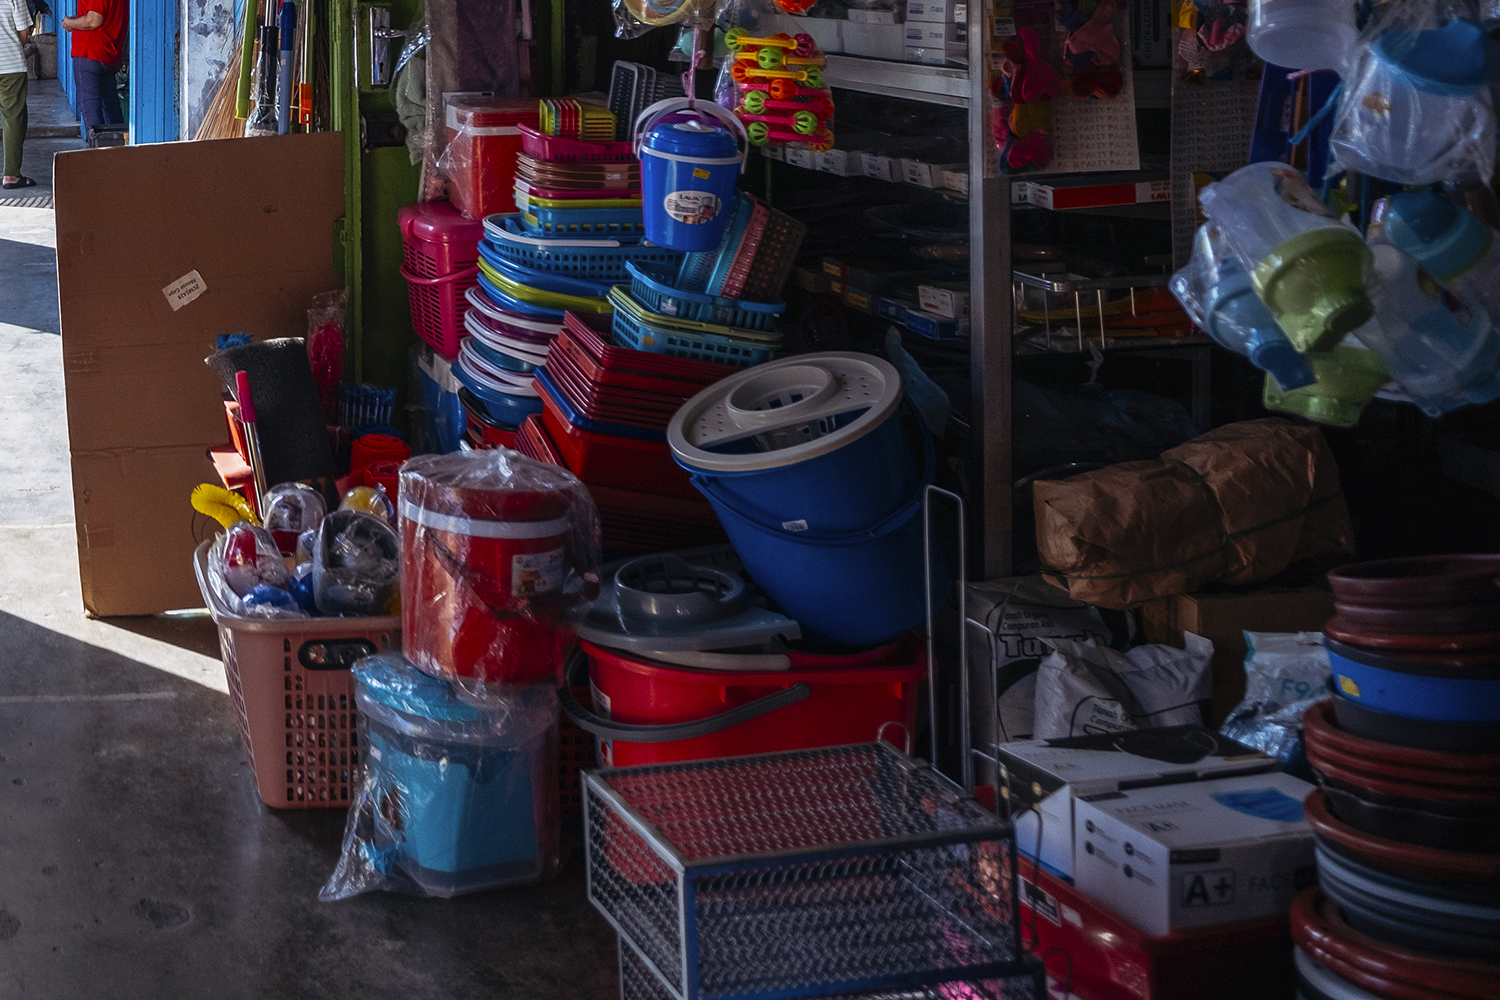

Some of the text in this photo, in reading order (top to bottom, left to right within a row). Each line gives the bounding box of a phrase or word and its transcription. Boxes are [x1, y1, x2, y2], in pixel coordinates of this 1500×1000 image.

[180, 279, 197, 290] Mouse
[1004, 610, 1022, 620] anah
[1002, 622, 1040, 631] Campuran
[1092, 703, 1119, 719] Tanah
[1185, 874, 1233, 905] A+
